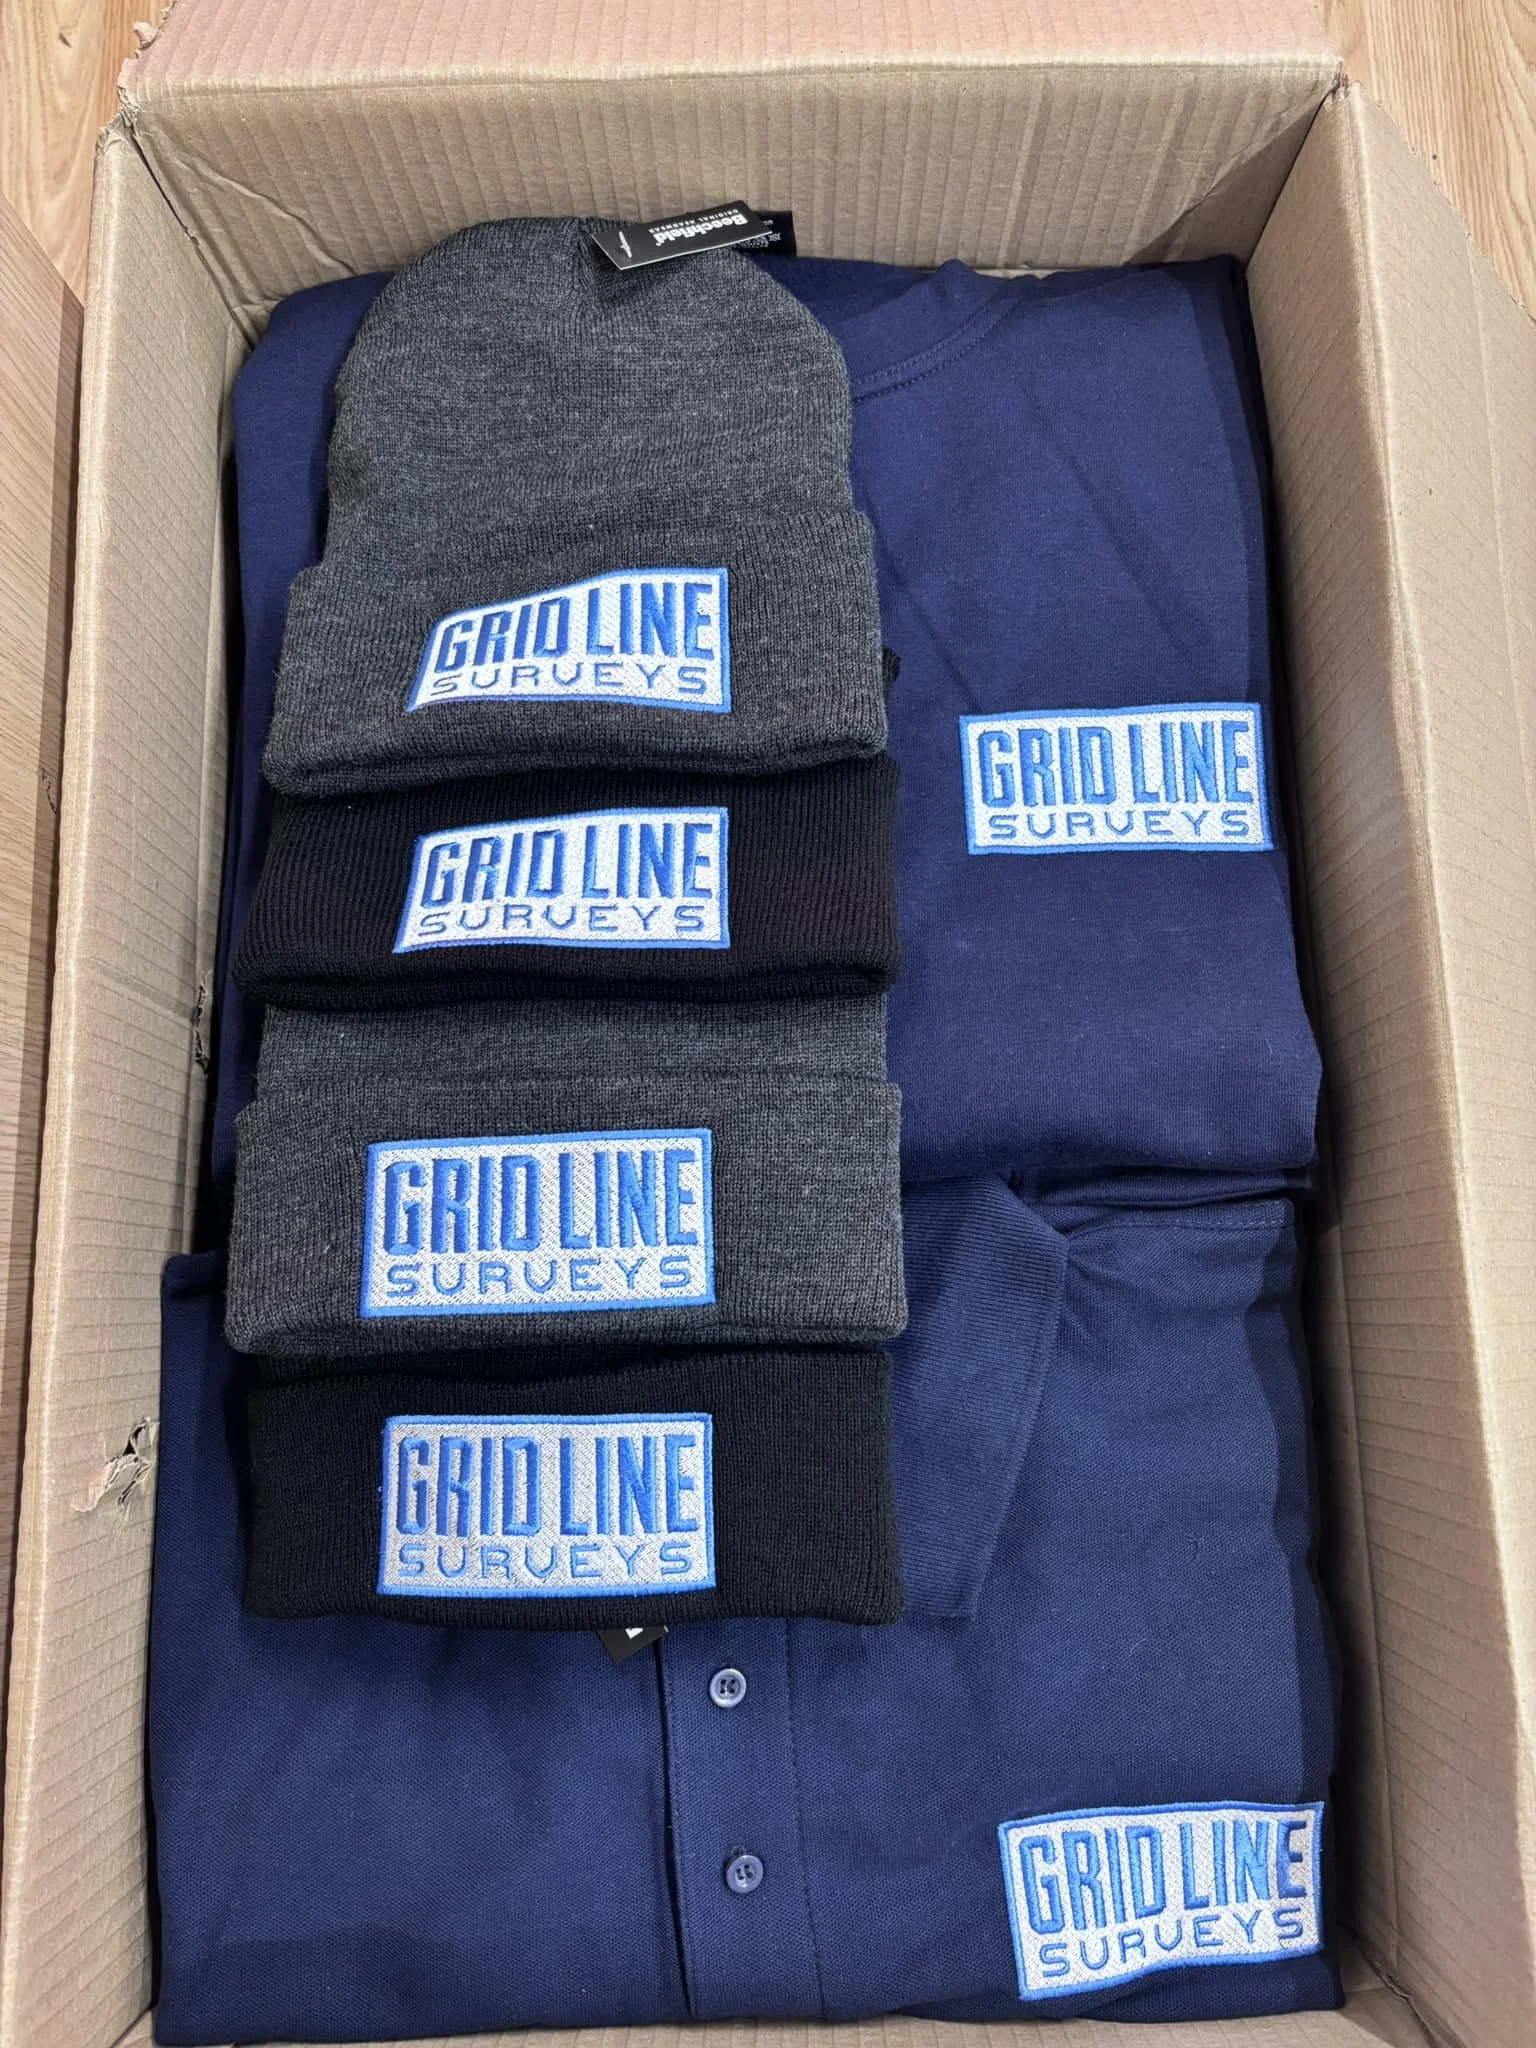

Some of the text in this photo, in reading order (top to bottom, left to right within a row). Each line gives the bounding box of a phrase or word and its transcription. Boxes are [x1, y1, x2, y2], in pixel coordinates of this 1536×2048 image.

[652, 213, 749, 245] Beechfield
[697, 208, 739, 222] ORIGINAL
[433, 582, 715, 674] GRID LINE
[430, 662, 708, 697] SURVEYS
[977, 720, 1254, 808] GRID LINE
[988, 810, 1250, 840] SURVEYS
[420, 822, 713, 909] GRID LINE
[417, 904, 706, 937] SURVEYS
[383, 1150, 698, 1256] GRID LINE
[386, 1255, 692, 1298] SURVEYS
[395, 1434, 699, 1537] GRID LINE
[399, 1541, 692, 1579] SURVEYS
[1018, 1819, 1307, 1935] GRID LINE
[1039, 1907, 1303, 1978] SURVEYS
